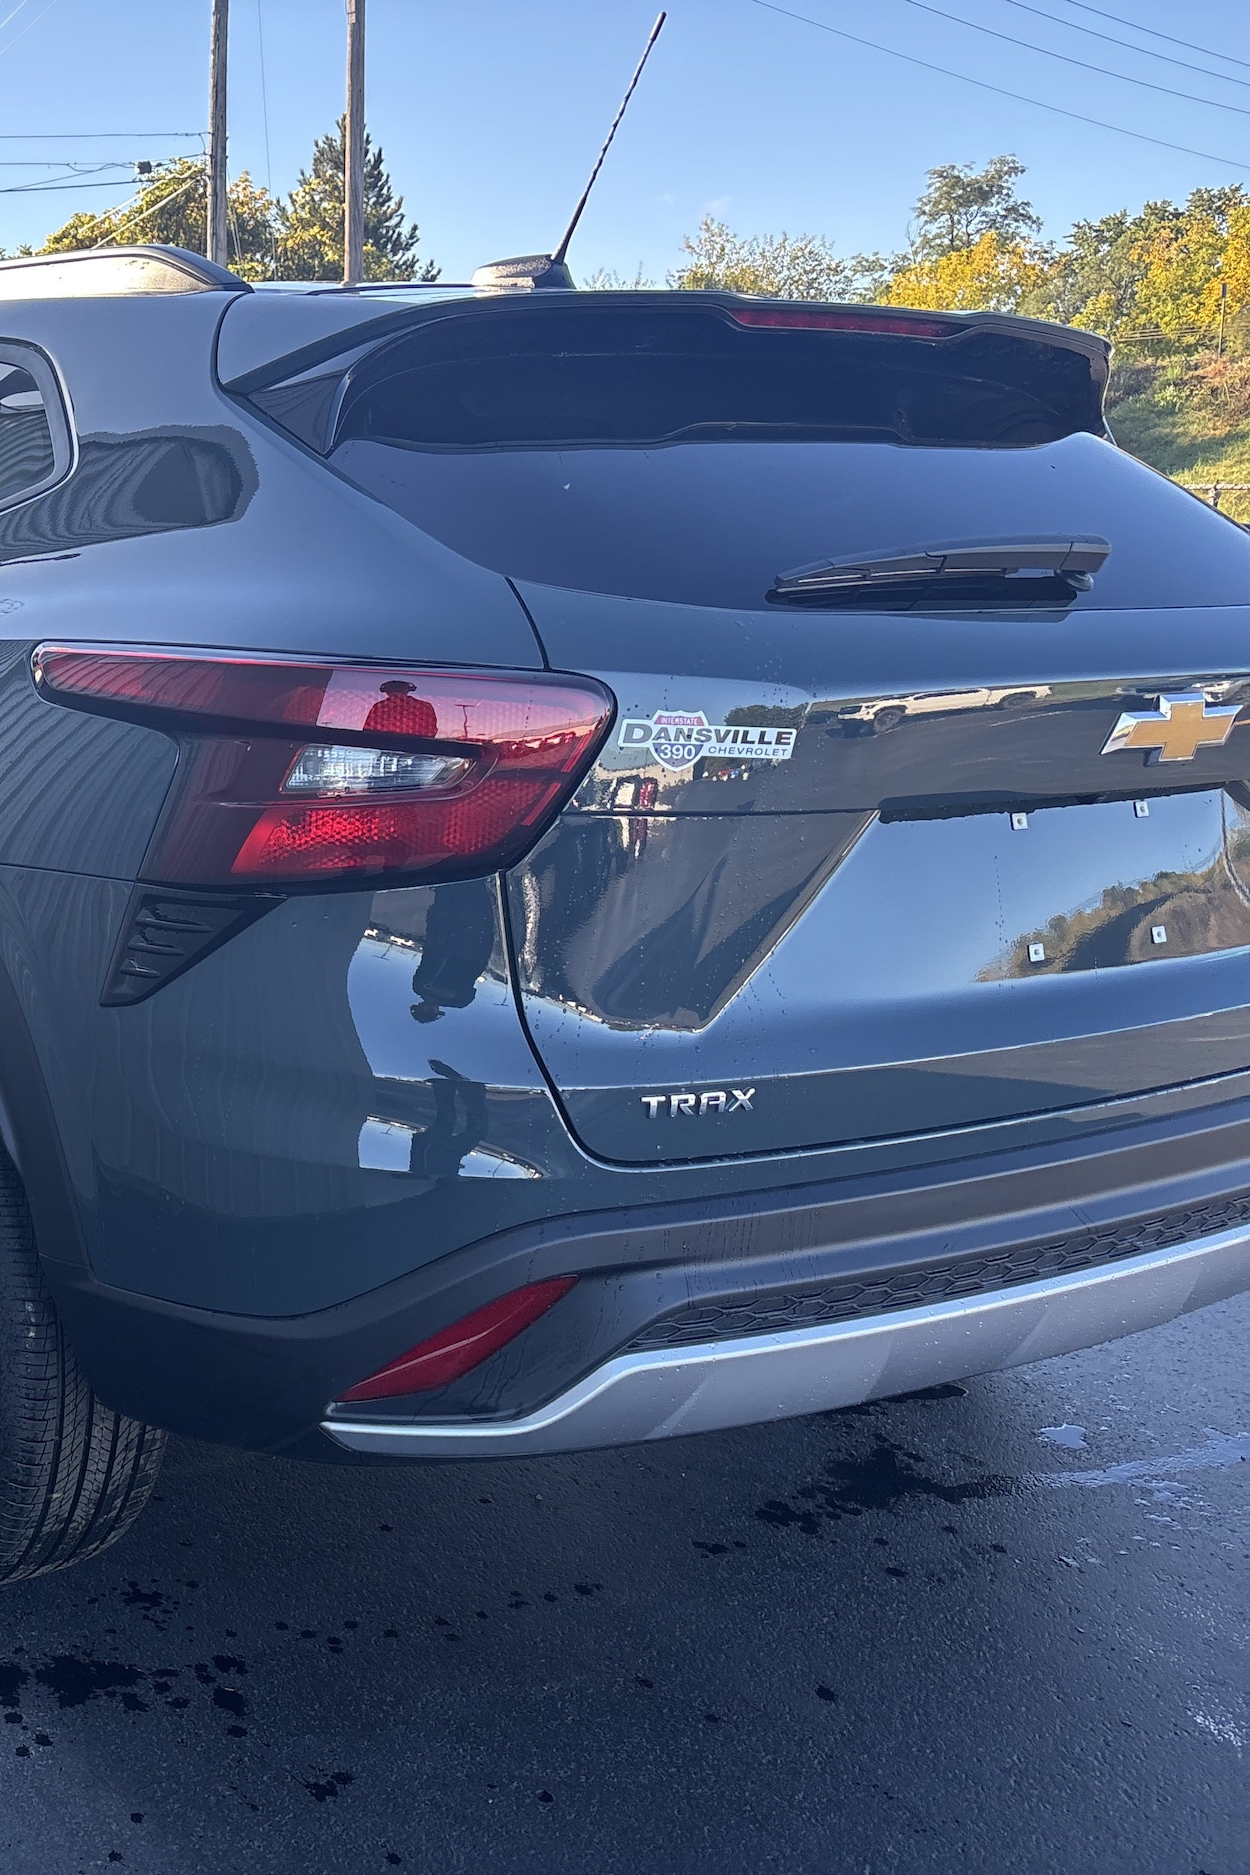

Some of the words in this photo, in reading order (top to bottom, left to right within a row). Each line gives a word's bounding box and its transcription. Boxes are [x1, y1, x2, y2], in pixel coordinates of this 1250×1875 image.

[660, 717, 698, 726] INTERSTATE
[622, 723, 793, 746] DANSVILLE
[659, 744, 696, 760] 390
[708, 746, 789, 757] CHEVROLET
[641, 1088, 756, 1119] TRAX
